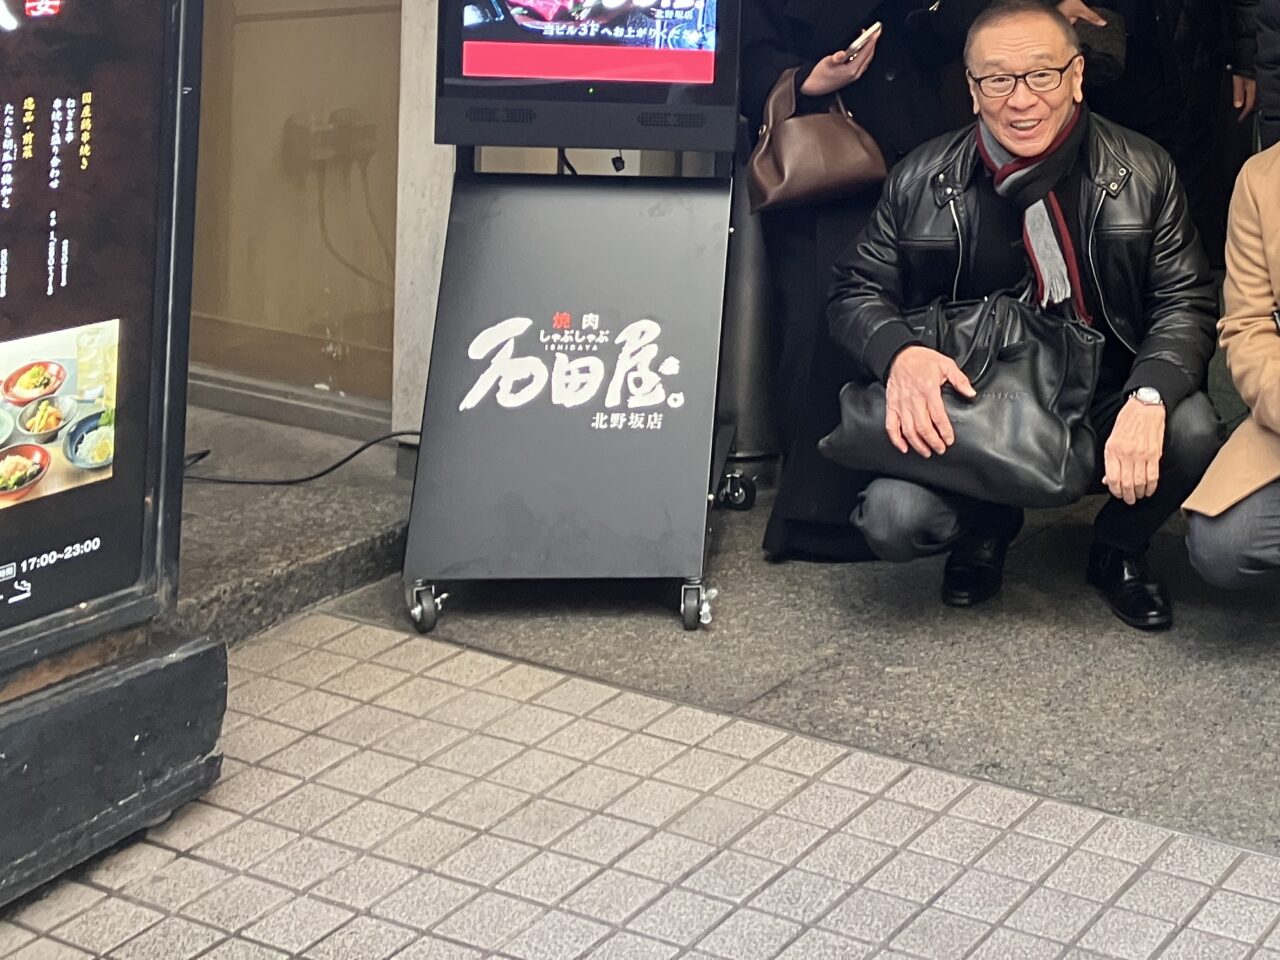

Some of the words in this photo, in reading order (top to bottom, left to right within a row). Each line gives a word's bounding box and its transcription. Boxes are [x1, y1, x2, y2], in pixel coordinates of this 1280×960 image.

[552, 311, 600, 330] 焼肉
[539, 329, 610, 343] しゃぶしゃぶ
[590, 411, 664, 431] 北野坂店
